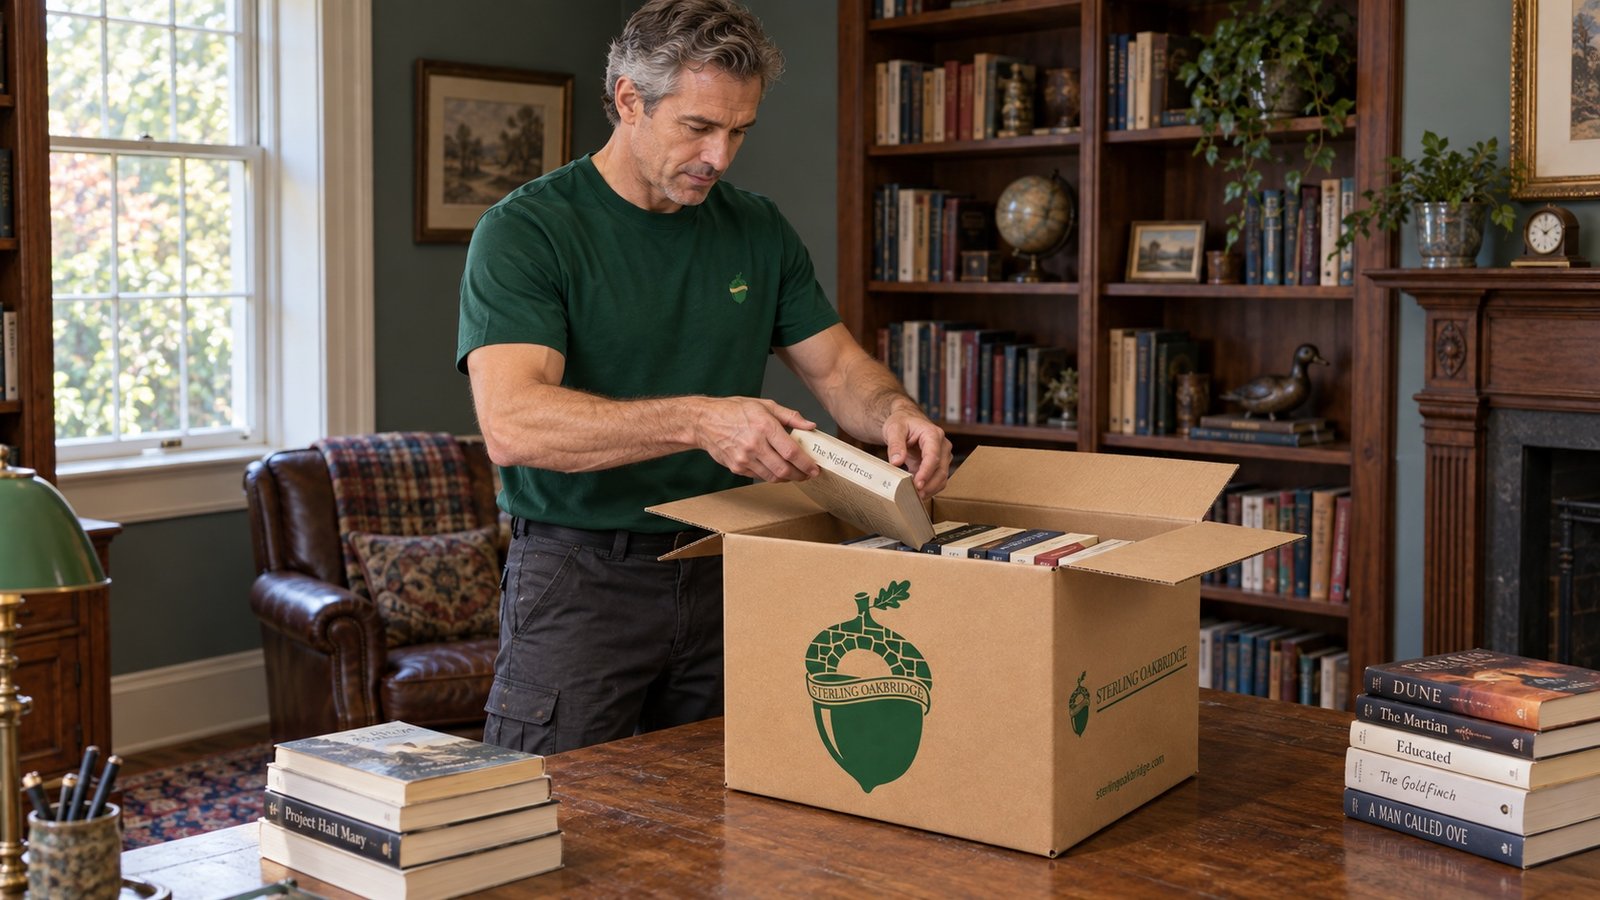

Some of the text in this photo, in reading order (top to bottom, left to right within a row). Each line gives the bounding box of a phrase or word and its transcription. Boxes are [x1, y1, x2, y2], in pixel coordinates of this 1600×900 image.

[812, 444, 873, 480] The Night Circus
[1096, 670, 1139, 704] STERLING
[1140, 645, 1188, 682] OAKBRIDGE
[811, 681, 924, 700] STERLING OAKBRIDGE
[1393, 680, 1442, 704] DUNE
[1380, 706, 1400, 724] The
[1403, 709, 1448, 735] Martian
[1396, 739, 1452, 765] Educated
[1380, 770, 1398, 785] The
[285, 806, 367, 850] Project Hail Mary
[1368, 802, 1376, 818] A
[1379, 804, 1402, 825] MAN
[1404, 812, 1442, 837] CALLED
[1446, 824, 1468, 845] OVE
